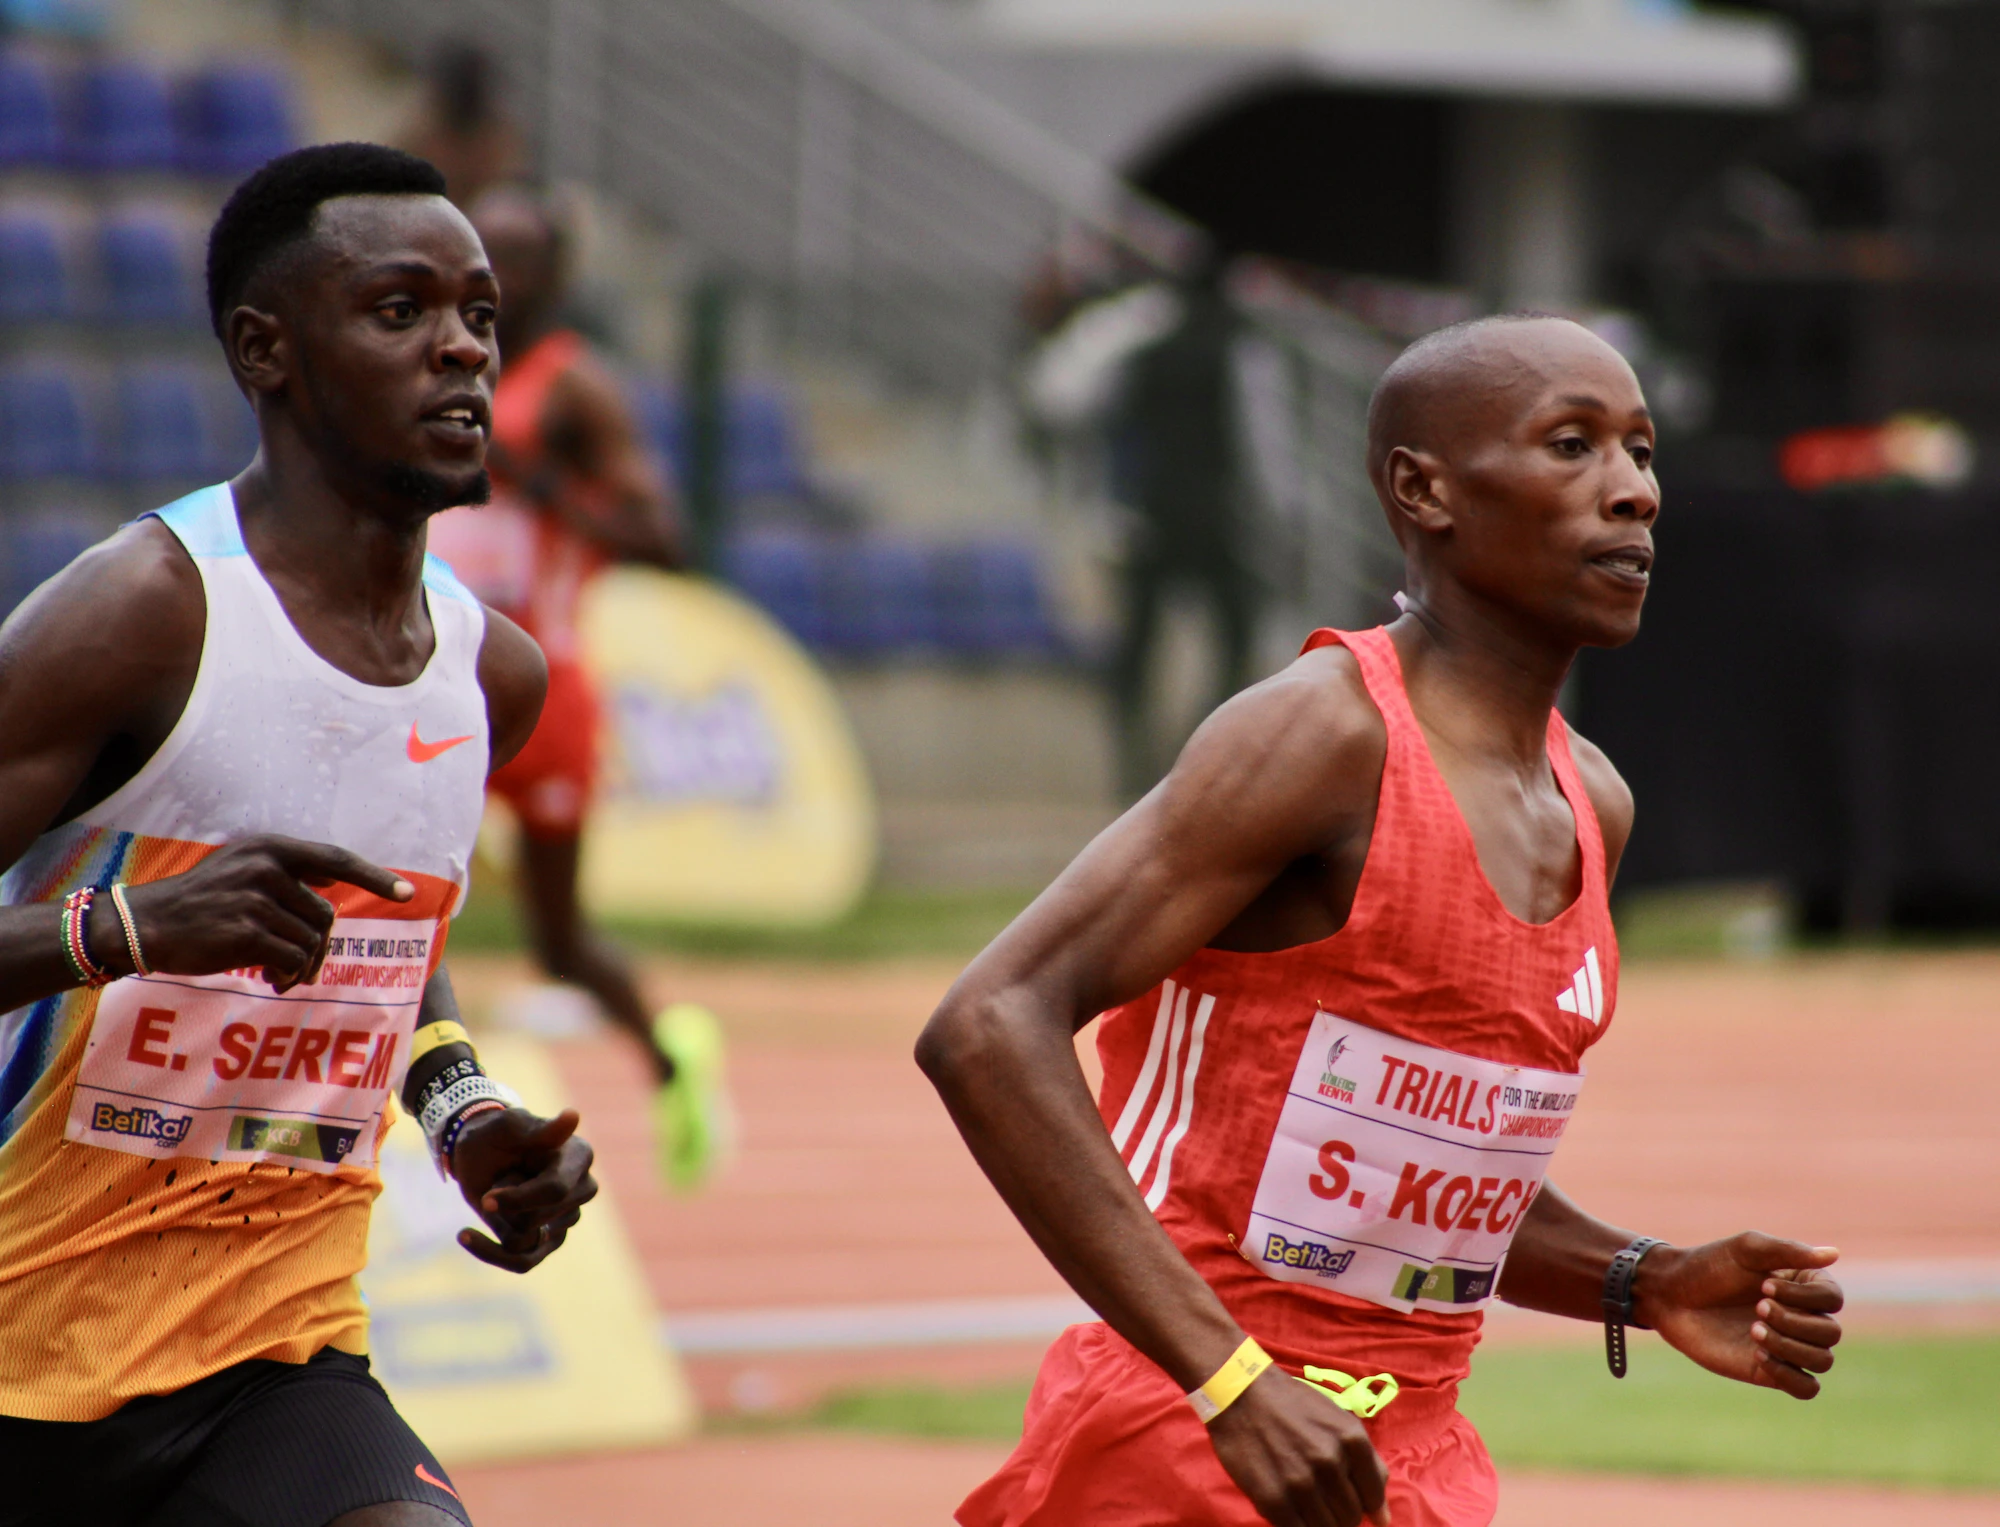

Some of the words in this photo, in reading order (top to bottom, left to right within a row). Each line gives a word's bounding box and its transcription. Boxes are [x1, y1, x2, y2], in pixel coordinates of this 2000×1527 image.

[326, 937, 345, 956] FOR
[347, 938, 365, 957] THE
[367, 939, 395, 958] WORLD
[395, 940, 427, 958] ATHLETICS
[321, 962, 404, 988] CHAMPIONSHIPS
[126, 1006, 188, 1072] E.
[212, 1021, 397, 1090] SEREM
[1317, 1082, 1354, 1105] KENYA
[1375, 1054, 1501, 1135] TRIALS
[1503, 1086, 1522, 1107] FOR
[1524, 1090, 1542, 1110] THE
[1539, 1092, 1566, 1111] WORLD
[91, 1101, 193, 1142] Betika!
[154, 1139, 178, 1149] .com
[266, 1128, 302, 1146] KCB
[1308, 1139, 1365, 1209] S.
[1262, 1232, 1357, 1273] Betika!
[1316, 1271, 1337, 1280] .com
